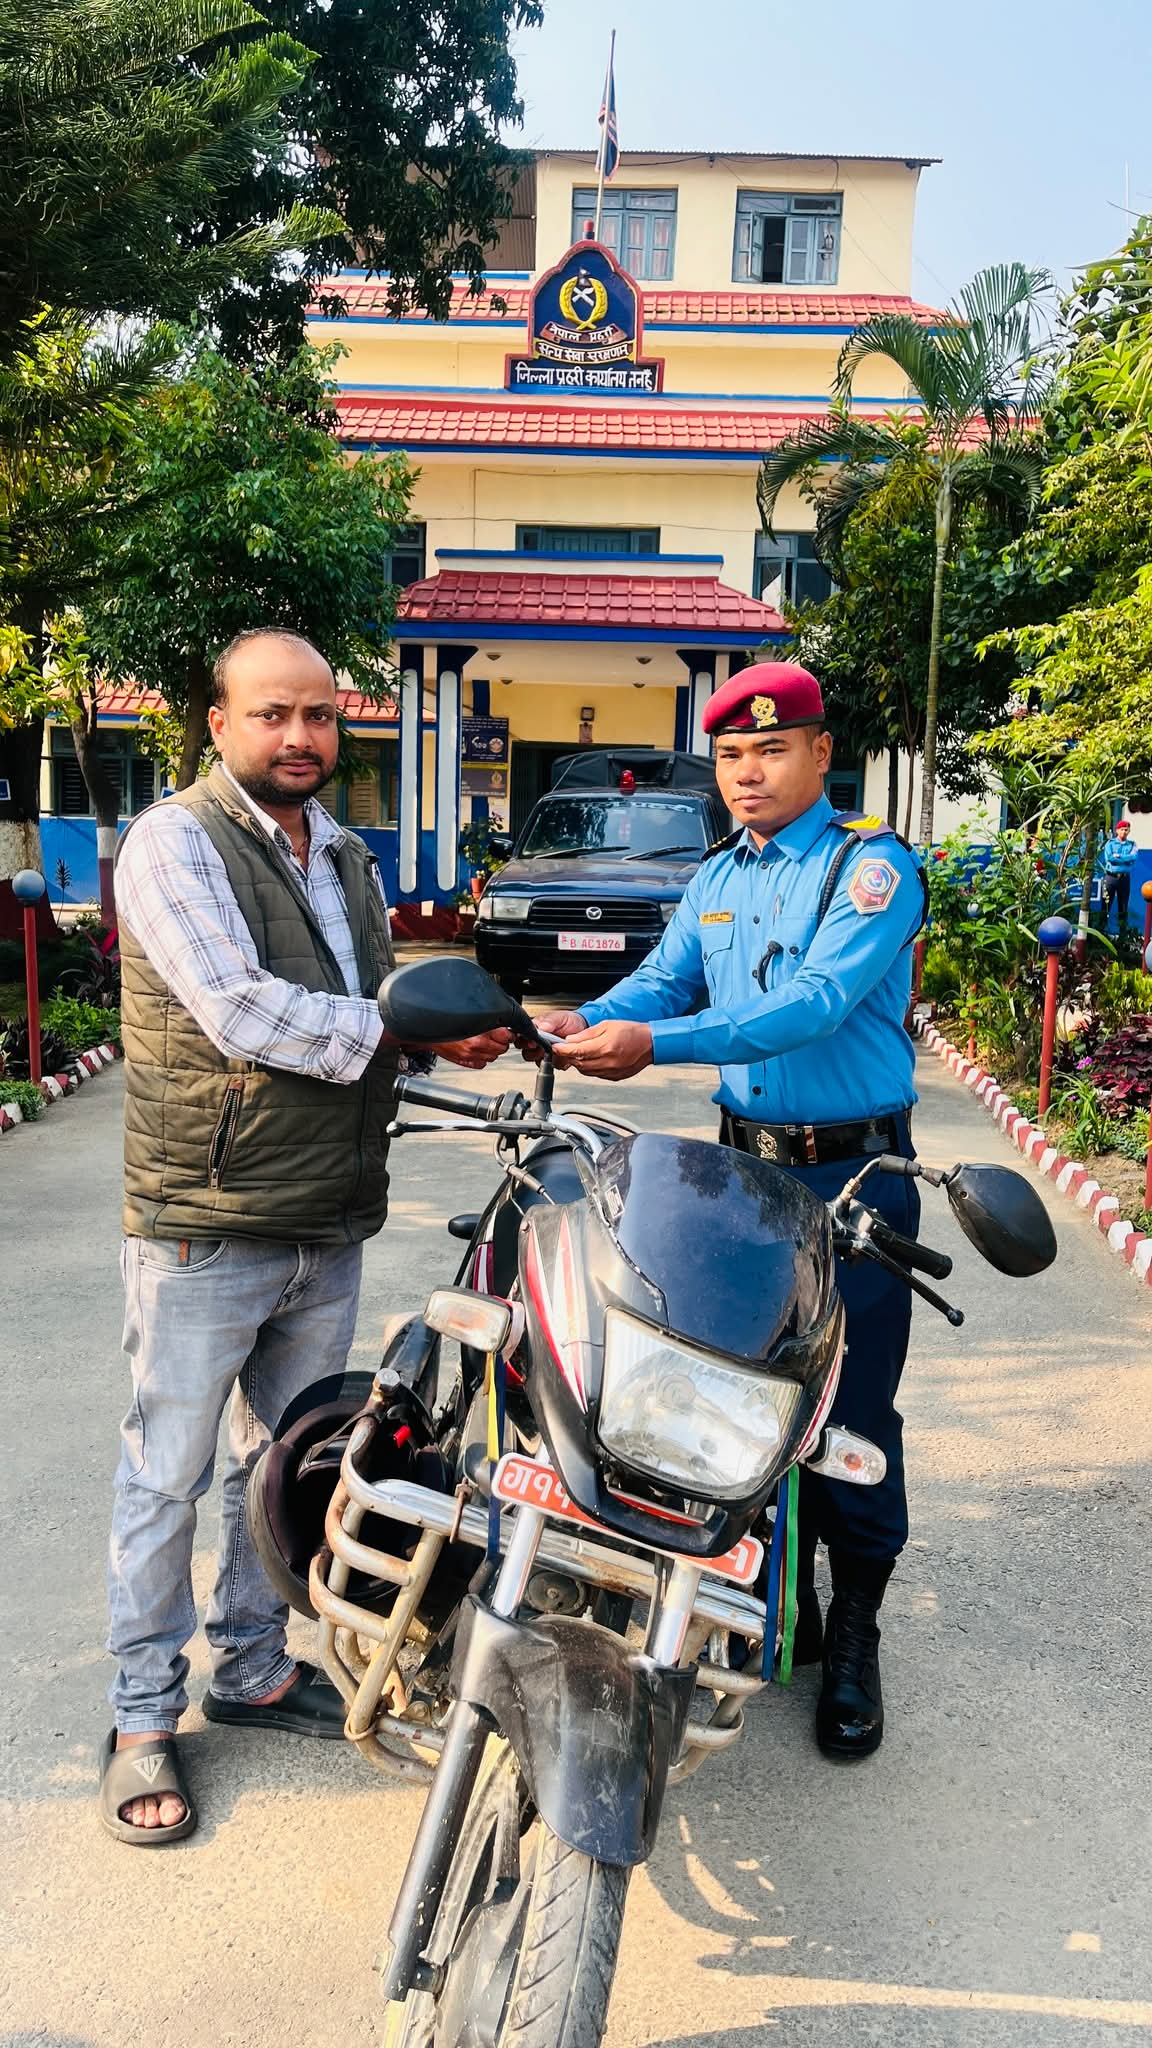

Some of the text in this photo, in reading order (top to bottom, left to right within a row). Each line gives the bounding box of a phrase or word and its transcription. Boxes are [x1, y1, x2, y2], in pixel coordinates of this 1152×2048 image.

[515, 361, 555, 385] जिल्ला
[556, 366, 584, 386] प्रहरी
[585, 367, 627, 388] कार्यालय
